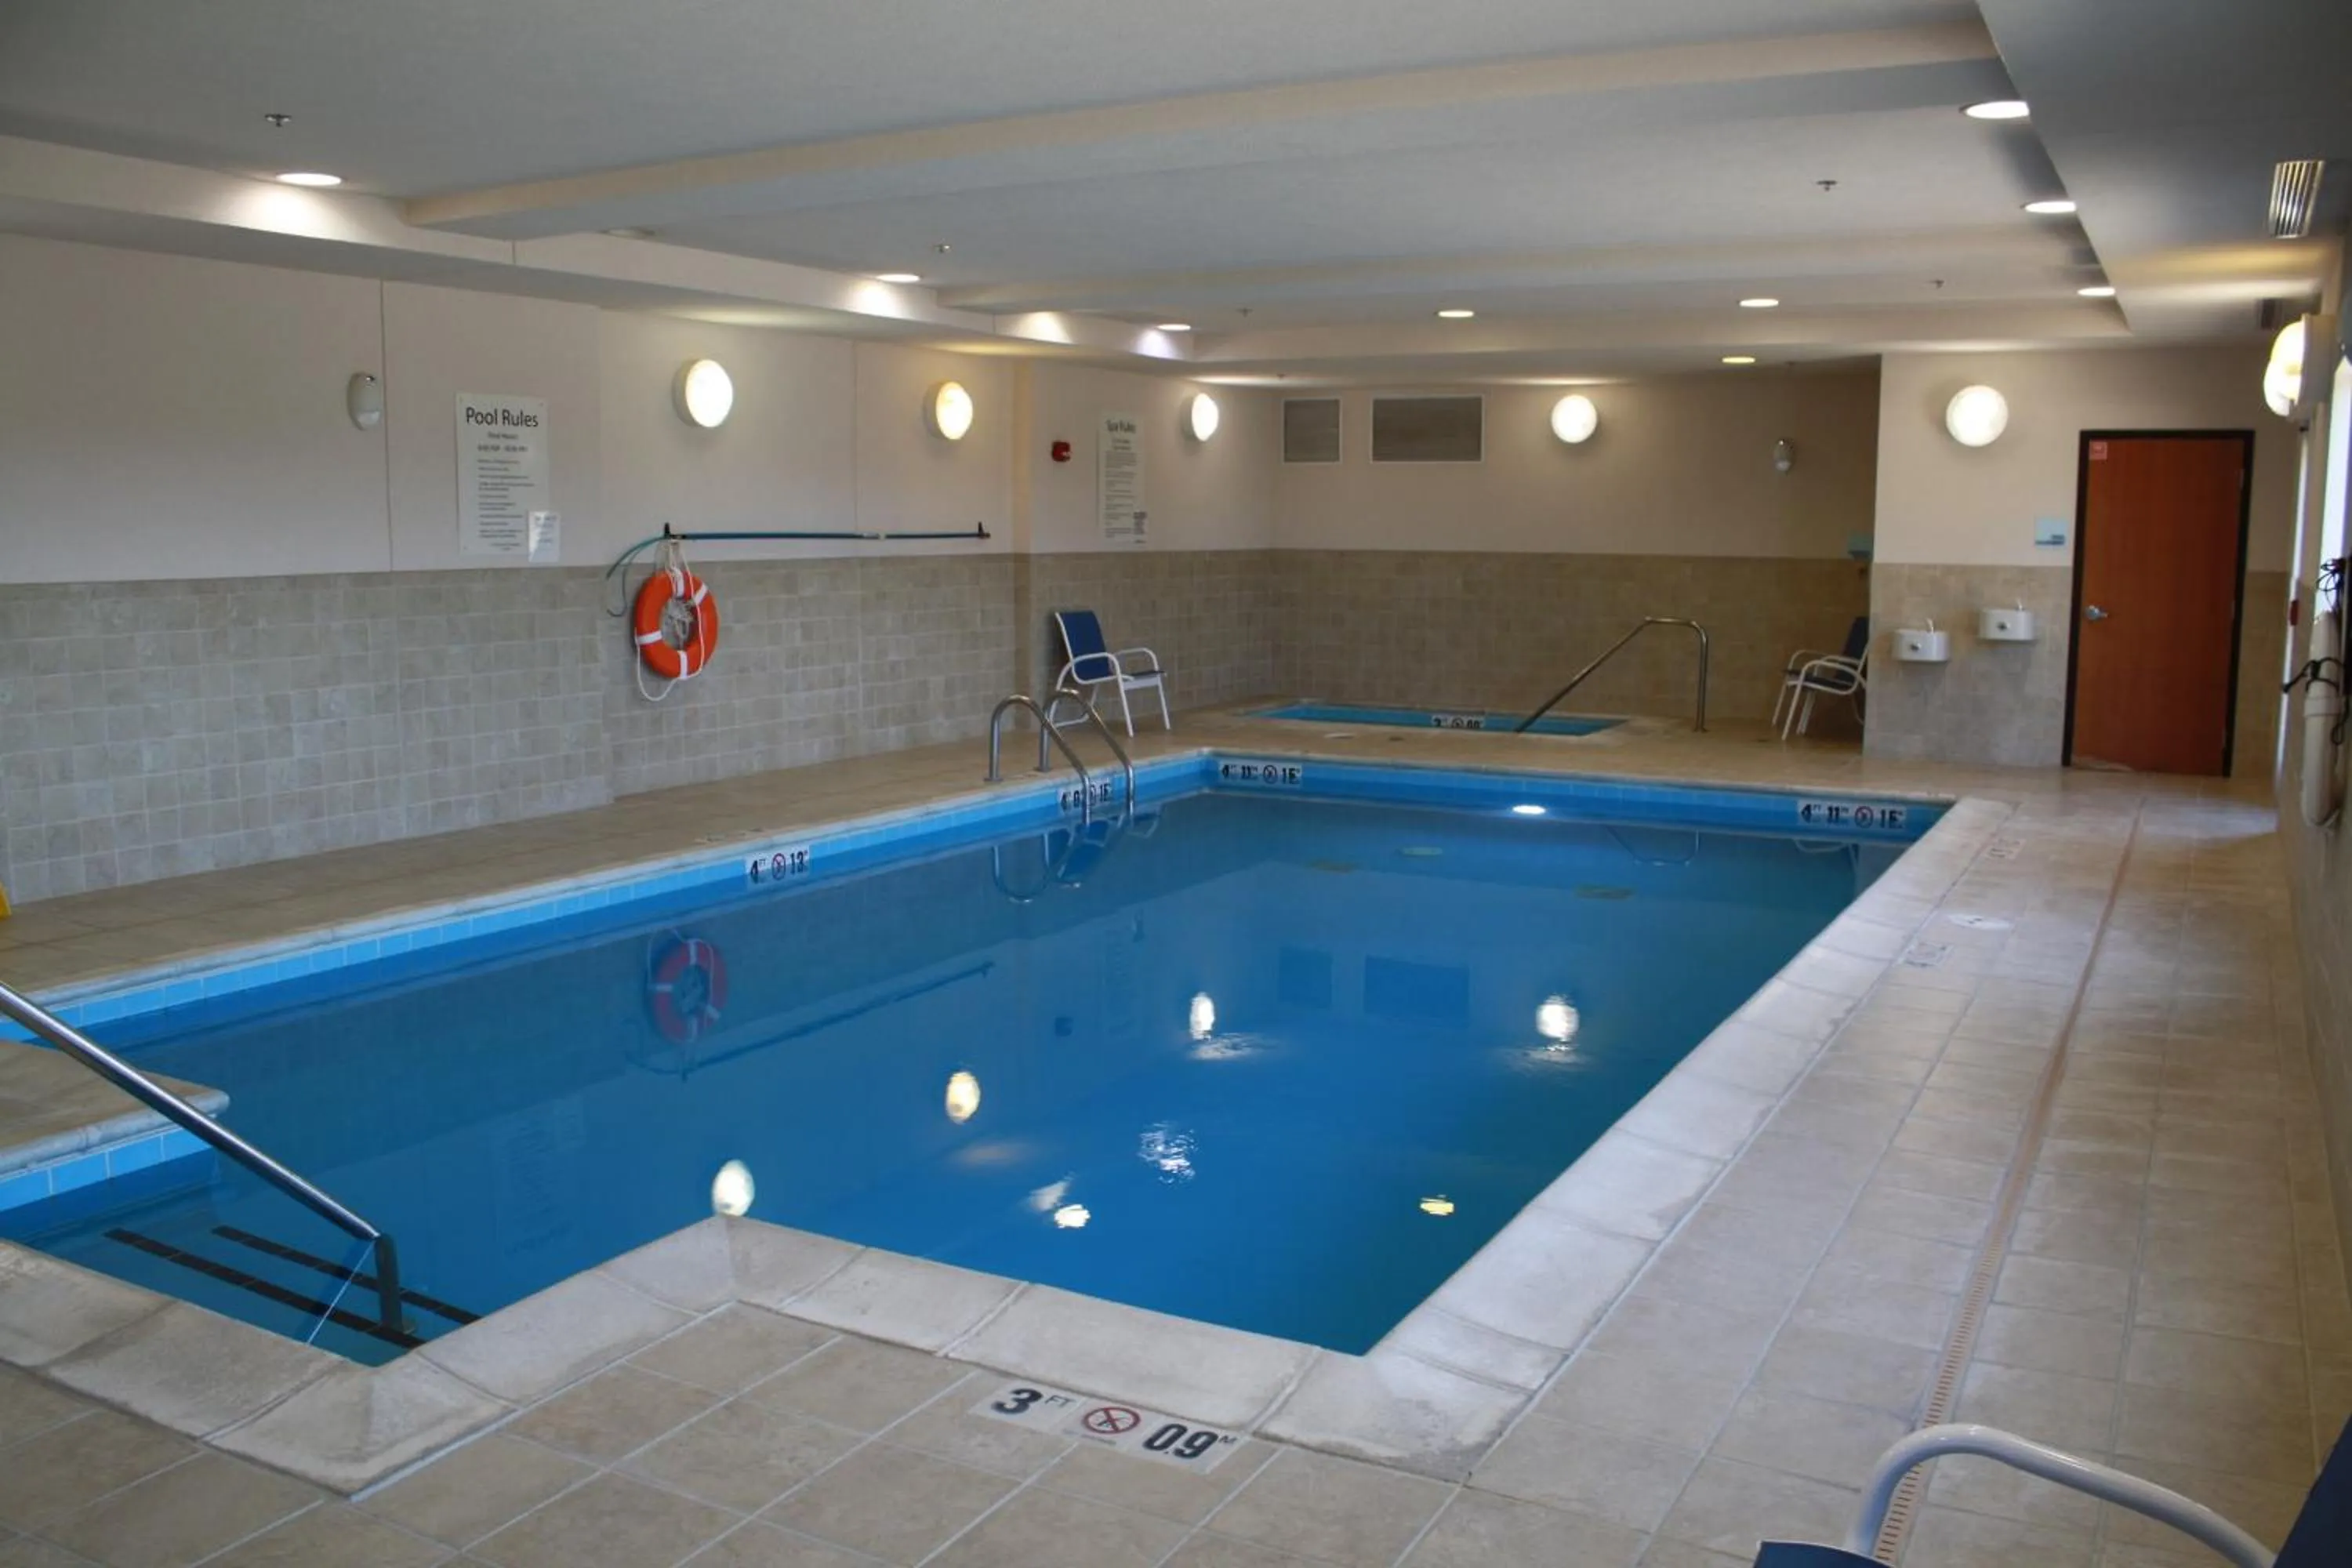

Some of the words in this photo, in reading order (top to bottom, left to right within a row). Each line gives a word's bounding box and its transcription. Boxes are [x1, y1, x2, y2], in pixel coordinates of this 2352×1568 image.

[466, 406, 498, 425] Pool
[502, 408, 539, 427] Rules
[991, 1388, 1043, 1414] 3
[1044, 1395, 1077, 1408] FT
[1142, 1423, 1219, 1459] 0.9
